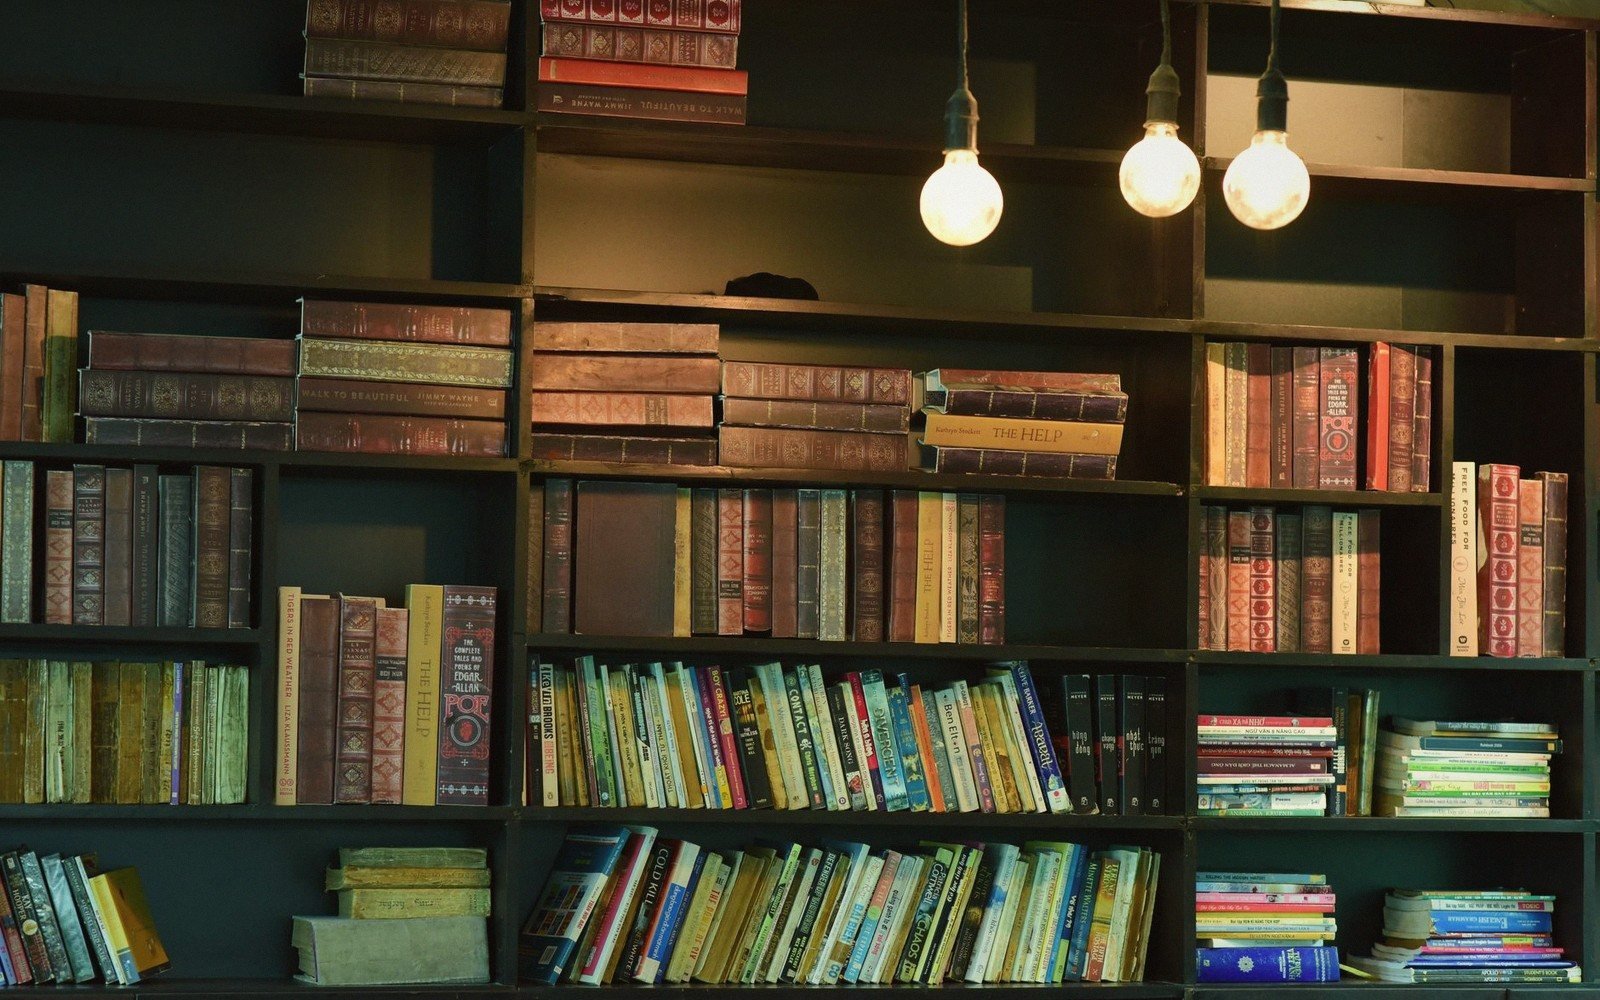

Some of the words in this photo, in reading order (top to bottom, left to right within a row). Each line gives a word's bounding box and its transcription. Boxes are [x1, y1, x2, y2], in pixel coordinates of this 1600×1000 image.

[571, 99, 601, 108] WAYNE
[604, 101, 632, 110] JIMMY
[641, 101, 695, 111] BEAUTIFUL
[716, 107, 742, 115] WALK
[302, 389, 330, 399] WALK
[334, 392, 347, 400] TO
[351, 392, 409, 402] BEAUTIFUL
[449, 394, 479, 402] WAYNE
[993, 428, 1018, 438] THE
[1021, 428, 1063, 442] HELP
[923, 538, 933, 570] HELP
[923, 574, 931, 592] THE
[286, 594, 294, 624] TIGERS
[287, 625, 293, 635] IN
[284, 660, 293, 698] WEATHER
[420, 658, 431, 688] THE
[454, 672, 483, 682] EDGAR
[710, 669, 720, 686] BOY
[1017, 666, 1028, 687] CLIVE
[452, 684, 480, 693] ALLAN
[714, 687, 725, 717] CRAZY!
[1022, 687, 1036, 714] BARKER
[416, 690, 432, 738] HELP
[444, 694, 489, 721] POE
[788, 687, 806, 735] CONTACT
[943, 703, 955, 724] Ben
[540, 705, 555, 740] BROOKS
[283, 723, 292, 775] KLAUSSMANN
[837, 716, 848, 740] DARK
[843, 741, 853, 764] SONG
[872, 706, 899, 788] DIVERGENT
[648, 846, 671, 880] COLD
[817, 851, 836, 887] DEFENDER
[922, 861, 944, 905] Cornwell
[931, 871, 946, 900] Patricia
[1084, 862, 1097, 893] MINETTE
[1100, 863, 1112, 894] STRONG
[1107, 863, 1119, 897] TERENCE
[11, 888, 26, 920] HOOPER
[21, 894, 32, 910] KAY
[641, 881, 659, 906] KILL
[708, 888, 720, 904] THE
[80, 898, 93, 927] MICHAEL
[1040, 908, 1048, 922] HELP
[1078, 894, 1091, 924] WALTERS
[1477, 916, 1507, 928] ENGLISH
[907, 919, 928, 959] CHAOS
[1035, 922, 1045, 949] YOURSELF
[1090, 930, 1101, 962] HOSTAGE
[623, 943, 640, 970] WHITE
[1096, 945, 1105, 962] FIFTH
[1029, 962, 1037, 980] TEENS
